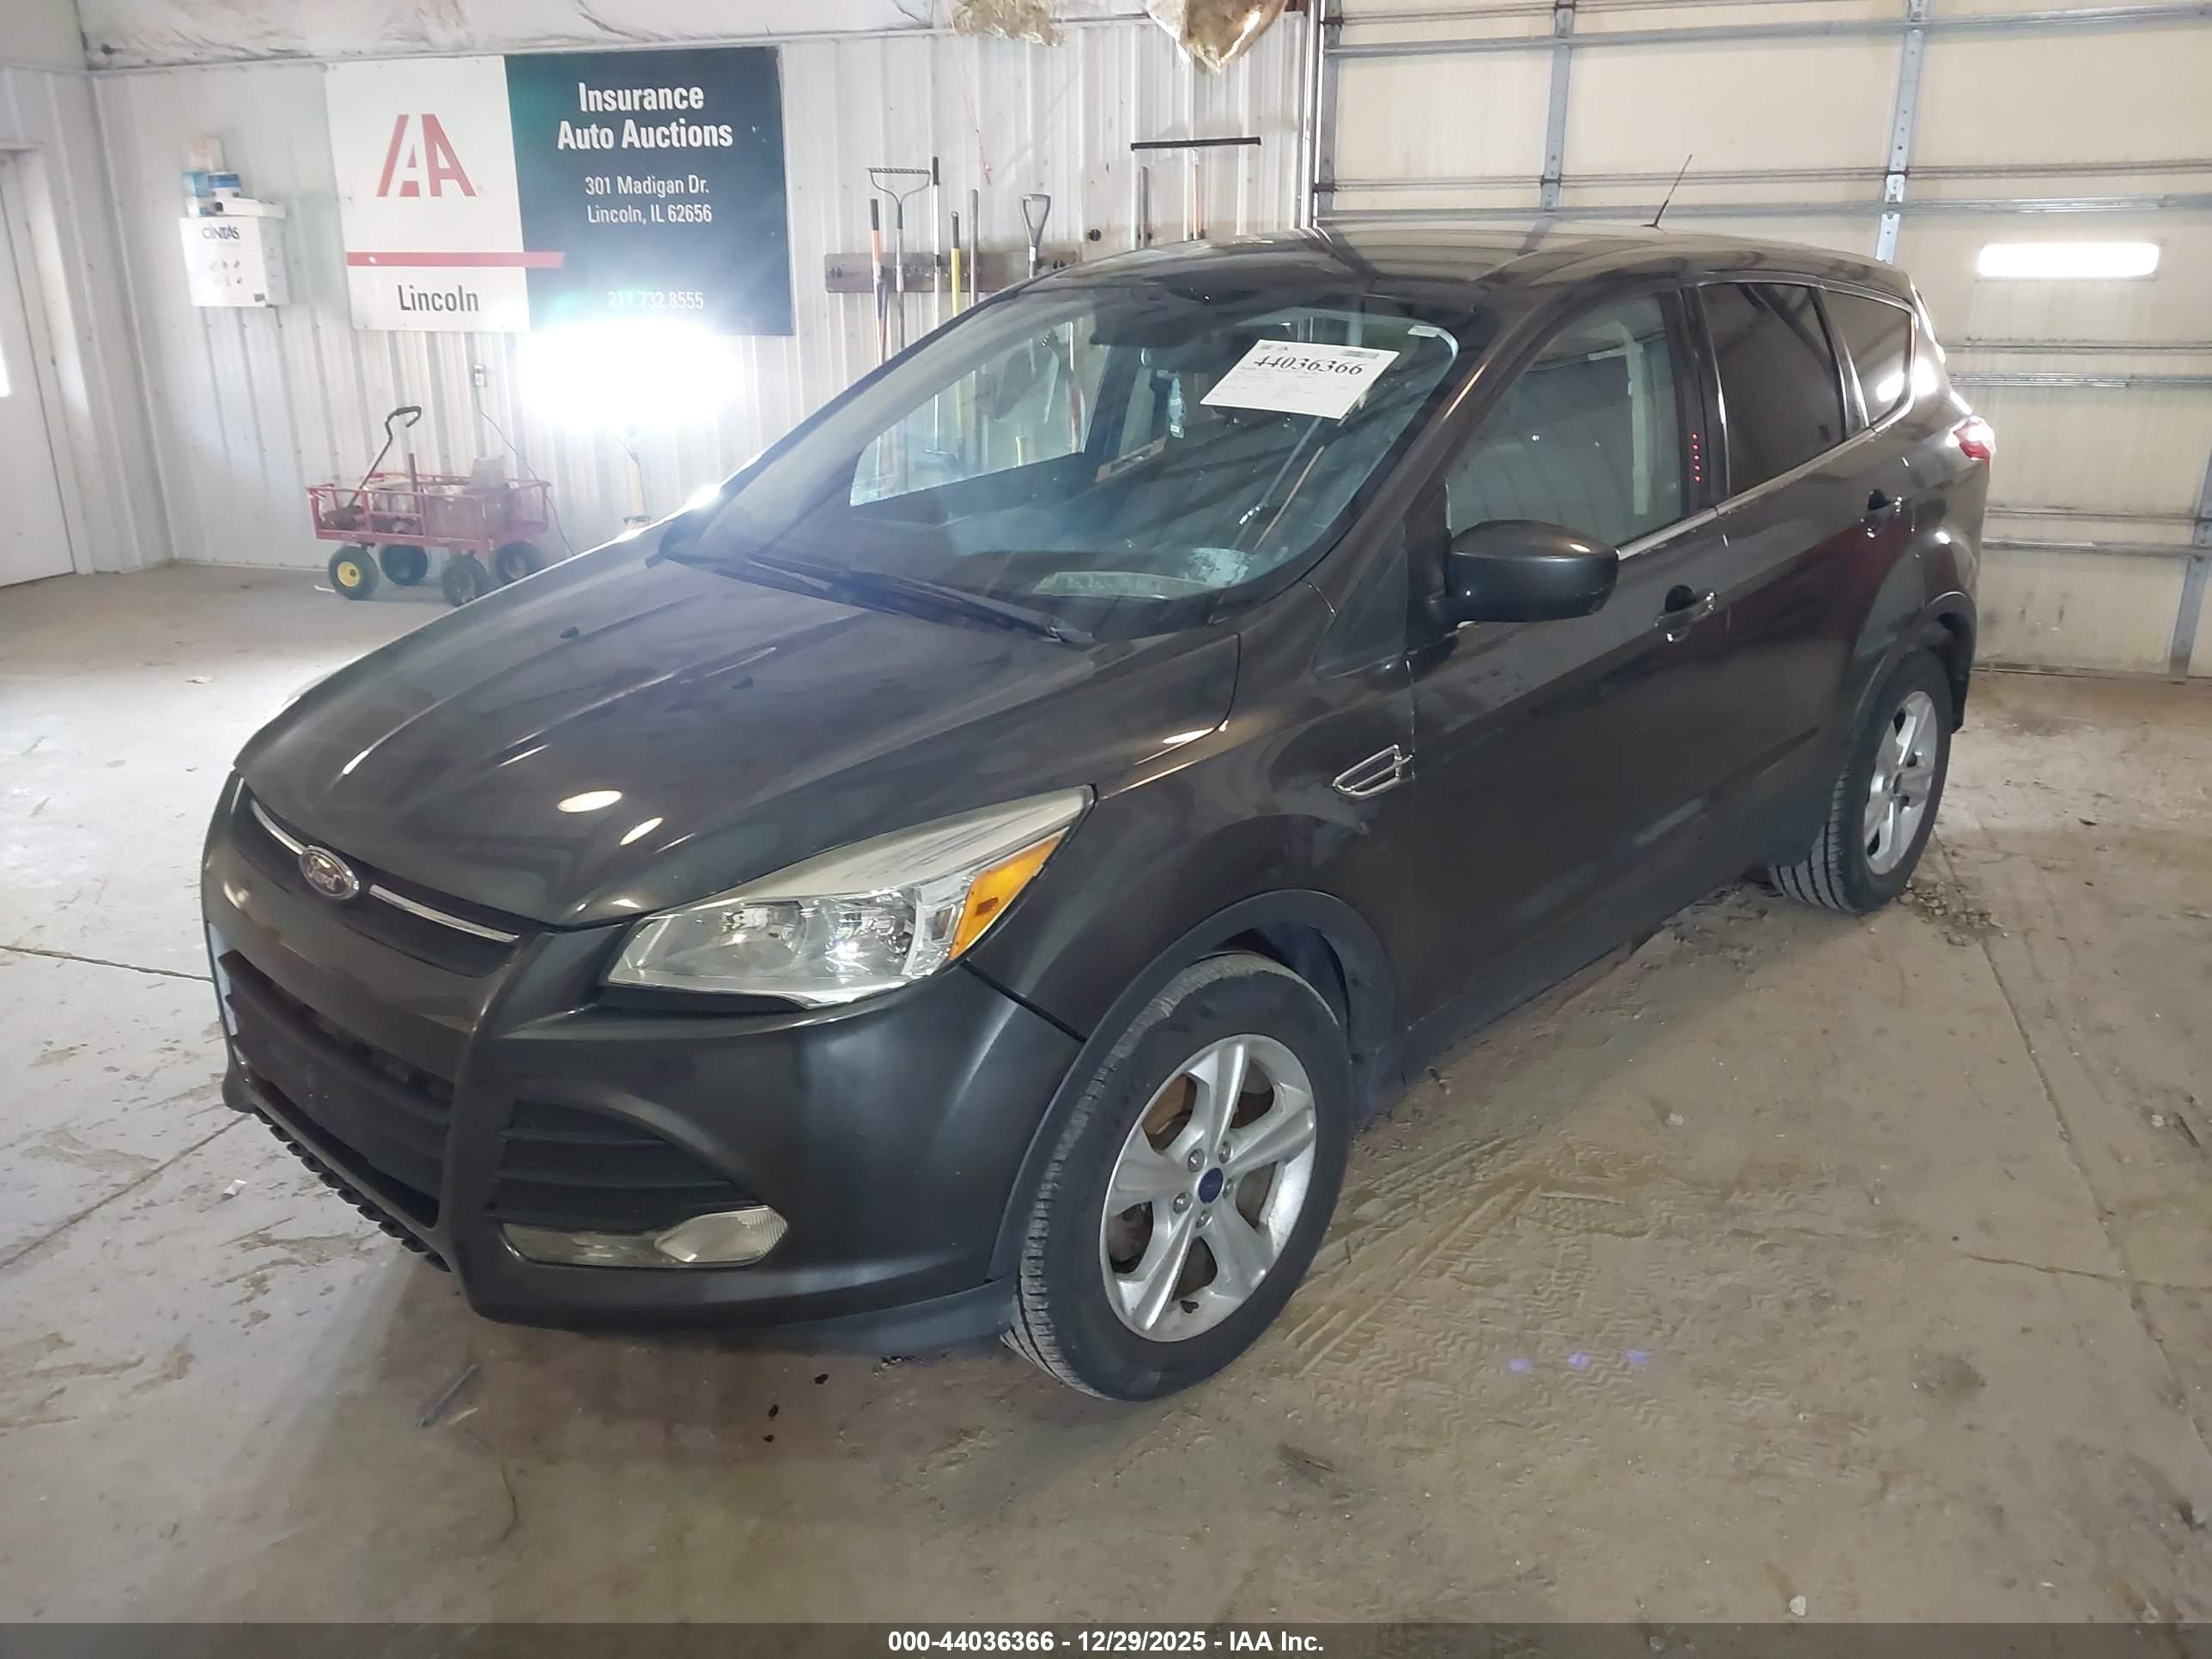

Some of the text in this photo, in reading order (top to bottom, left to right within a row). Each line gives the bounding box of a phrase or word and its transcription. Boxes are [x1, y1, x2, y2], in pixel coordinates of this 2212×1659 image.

[578, 82, 704, 112] Insurance
[558, 118, 733, 149] Auto Auctions
[585, 174, 709, 198] 301 Madigan Dr.
[587, 204, 712, 225] Lincoln, IL 62656
[398, 284, 479, 312] Lincoln
[608, 290, 704, 310] 217.732.8555
[1254, 356, 1367, 375] 44036366
